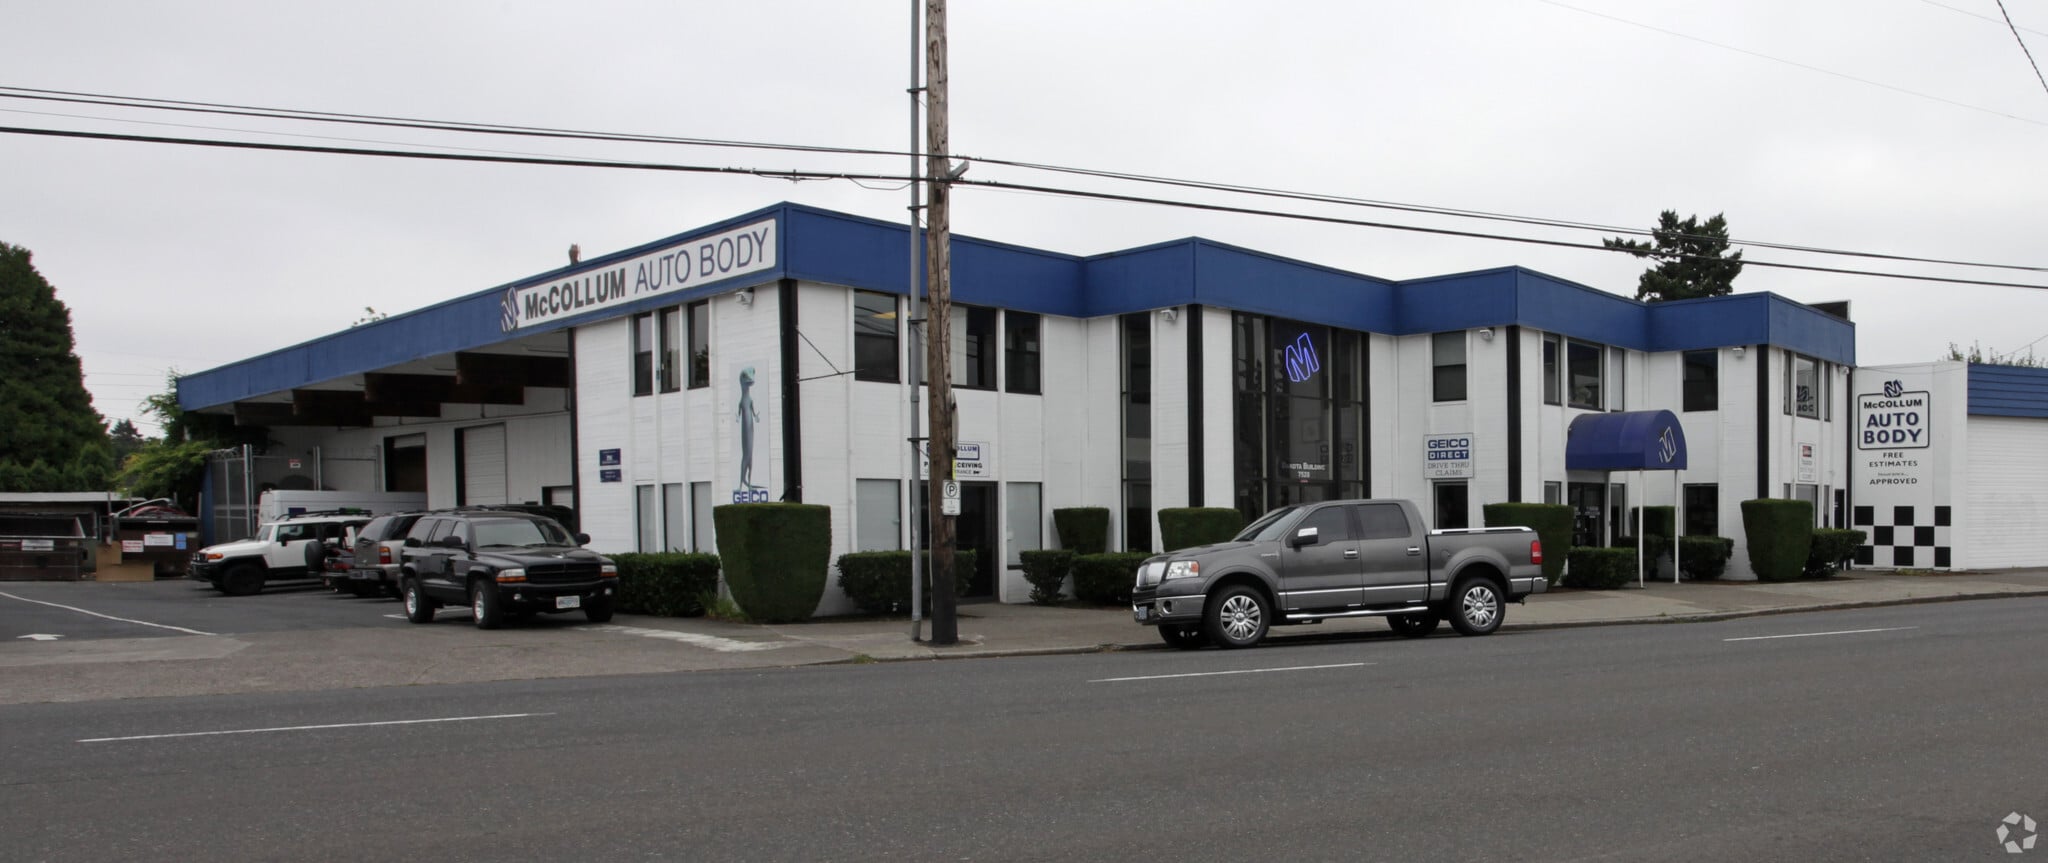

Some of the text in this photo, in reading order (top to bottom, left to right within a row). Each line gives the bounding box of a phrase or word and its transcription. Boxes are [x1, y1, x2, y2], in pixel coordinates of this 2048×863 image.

[525, 268, 626, 320] McCOLLUM
[635, 250, 691, 294] AUTO
[700, 227, 769, 277] BODY
[1286, 332, 1320, 382] M
[1863, 399, 1922, 409] McCOLLUM
[1866, 412, 1919, 428] AUTO
[1863, 428, 1922, 444] BODY
[1428, 438, 1469, 449] GEICO
[1429, 450, 1468, 459] DIRECT
[1869, 460, 1918, 468] ESTIMATES
[1869, 477, 1918, 485] APPROVED
[733, 490, 769, 503] GEICO
